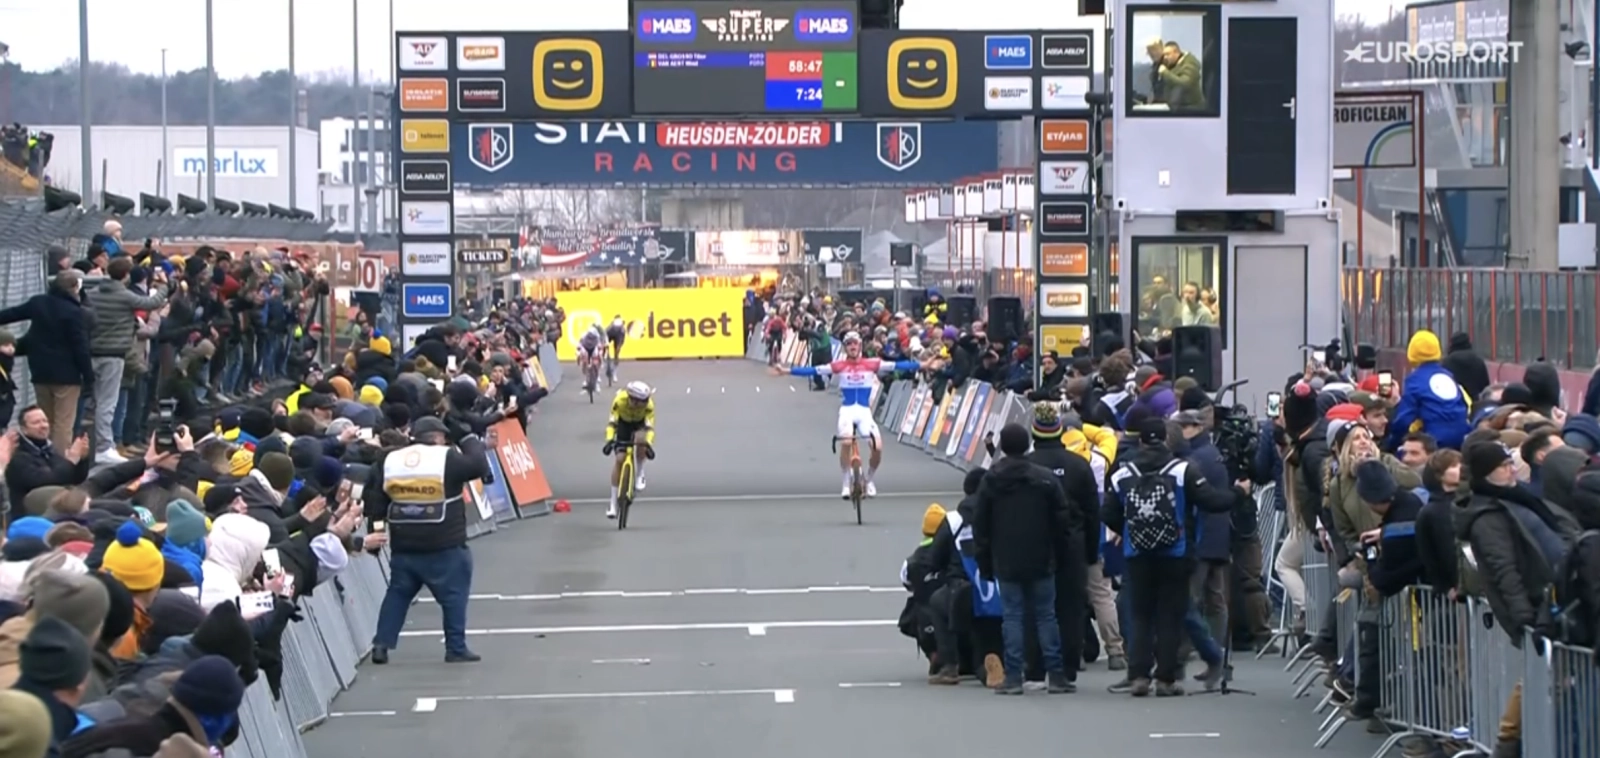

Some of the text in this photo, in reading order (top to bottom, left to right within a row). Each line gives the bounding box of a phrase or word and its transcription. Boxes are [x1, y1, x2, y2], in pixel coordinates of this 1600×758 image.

[652, 19, 692, 34] MAES
[718, 17, 773, 33] SUPER
[809, 19, 848, 34] MAES
[718, 33, 774, 41] PRESTIGE
[998, 47, 1026, 58] MAES
[795, 87, 823, 101] 7:24
[665, 124, 822, 146] HEUSDEN-ZOLDER
[183, 150, 266, 174] marlux
[594, 151, 797, 172] RACING
[406, 172, 423, 180] ASSA
[461, 250, 504, 262] TICKETS
[416, 295, 445, 306] MAES
